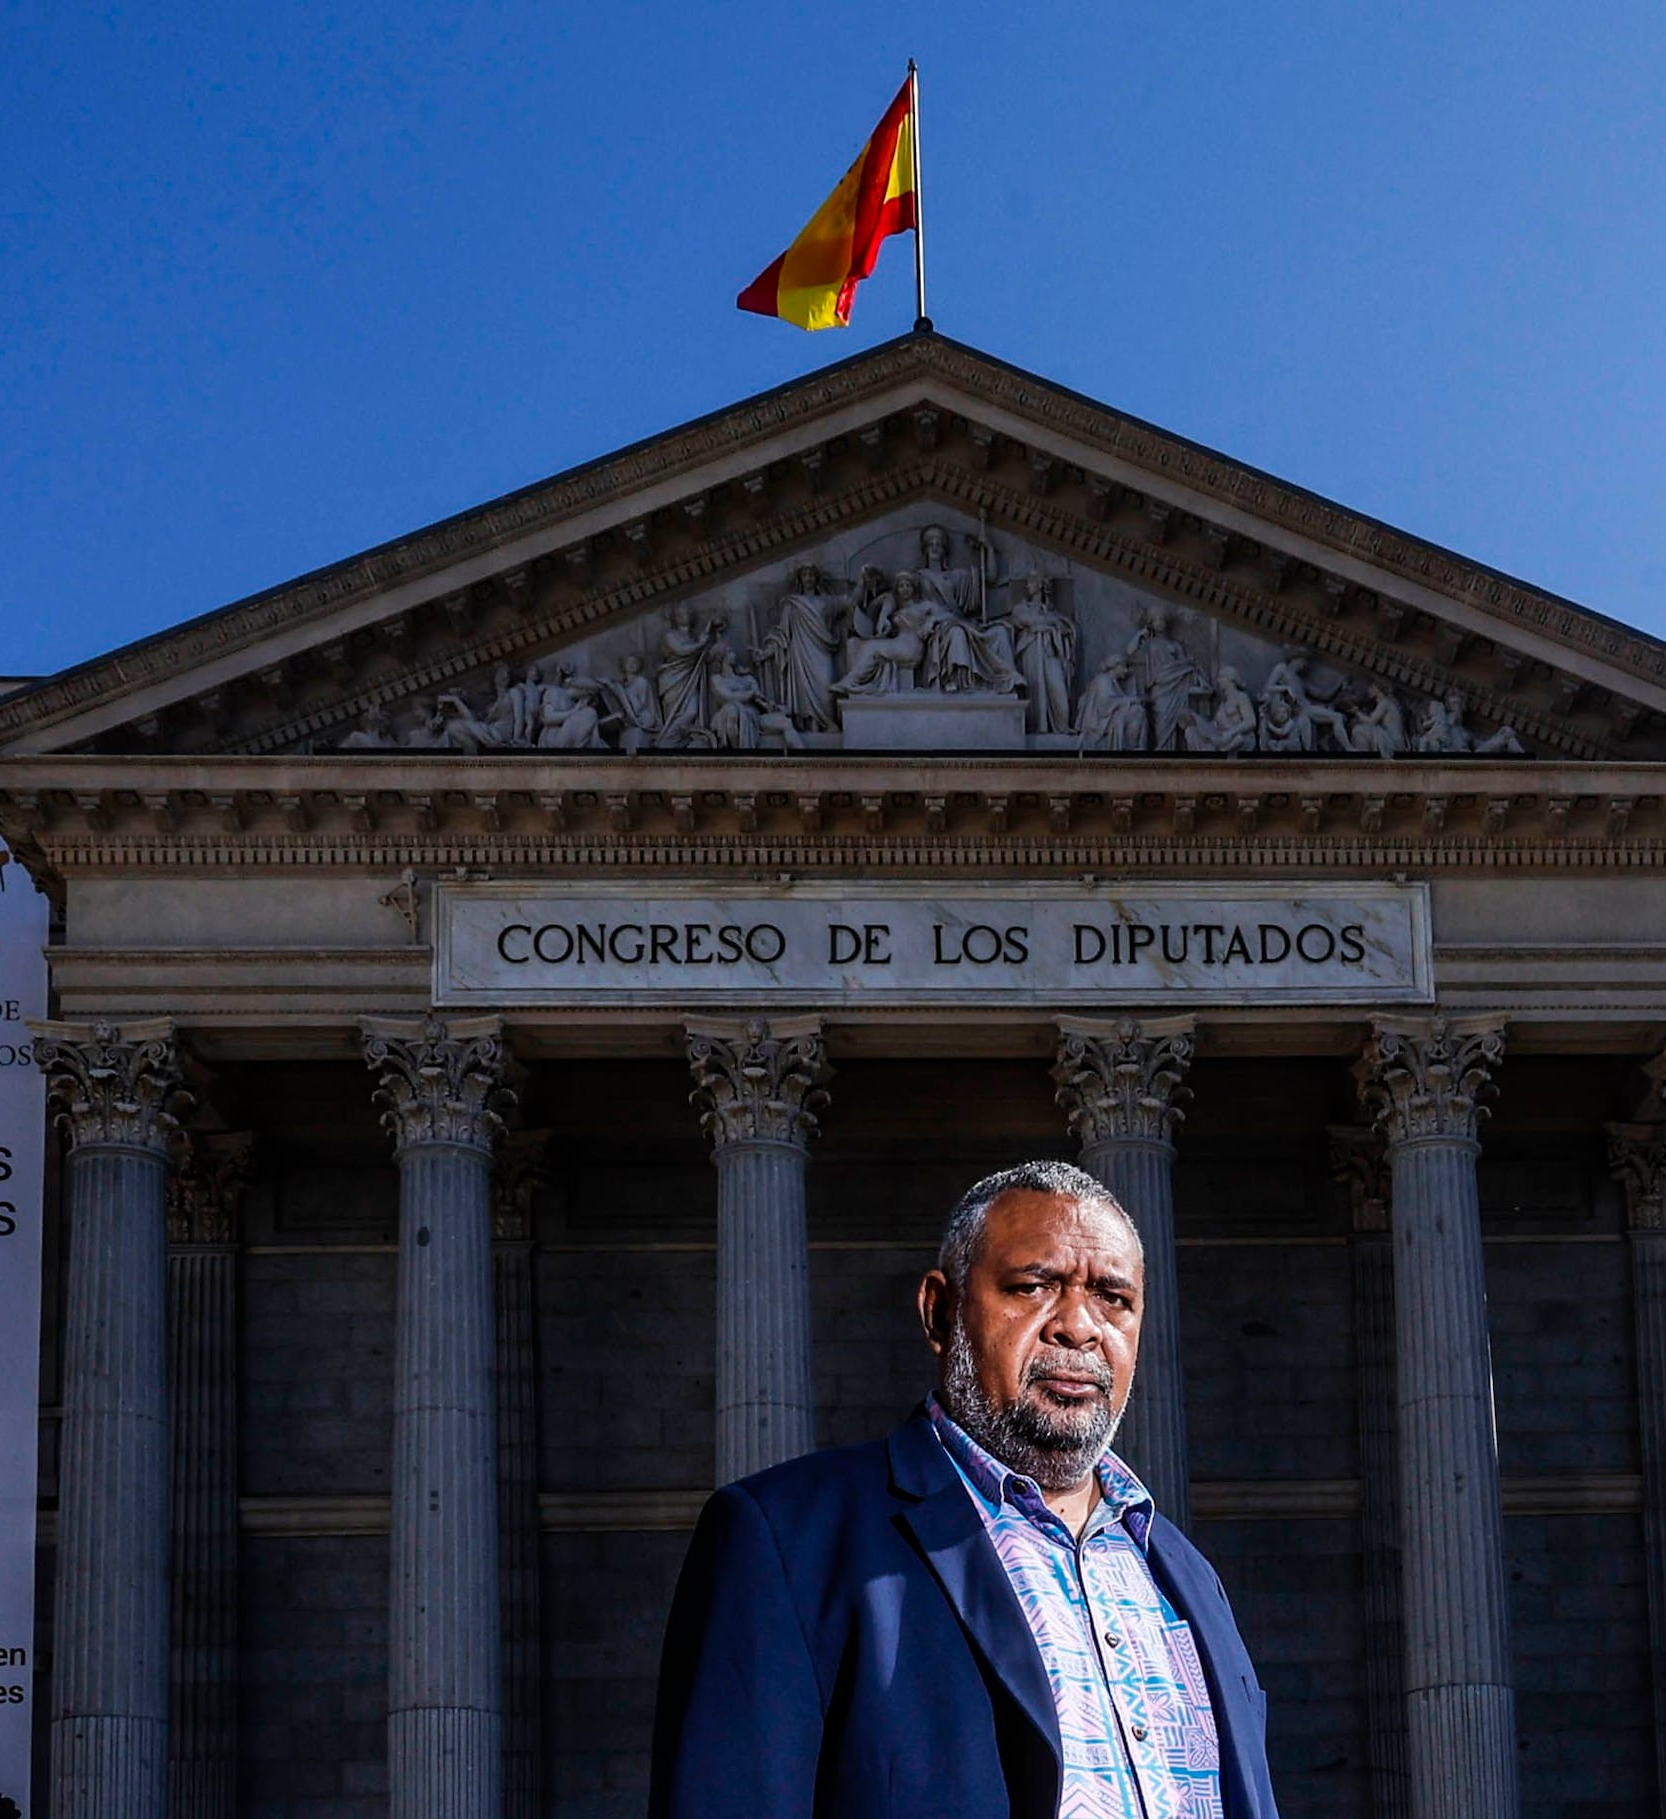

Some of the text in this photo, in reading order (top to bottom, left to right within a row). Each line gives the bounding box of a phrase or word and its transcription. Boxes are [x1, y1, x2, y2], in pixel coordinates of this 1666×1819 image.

[497, 922, 1366, 966] CONGRESO DE LOS DIPUTADOS
